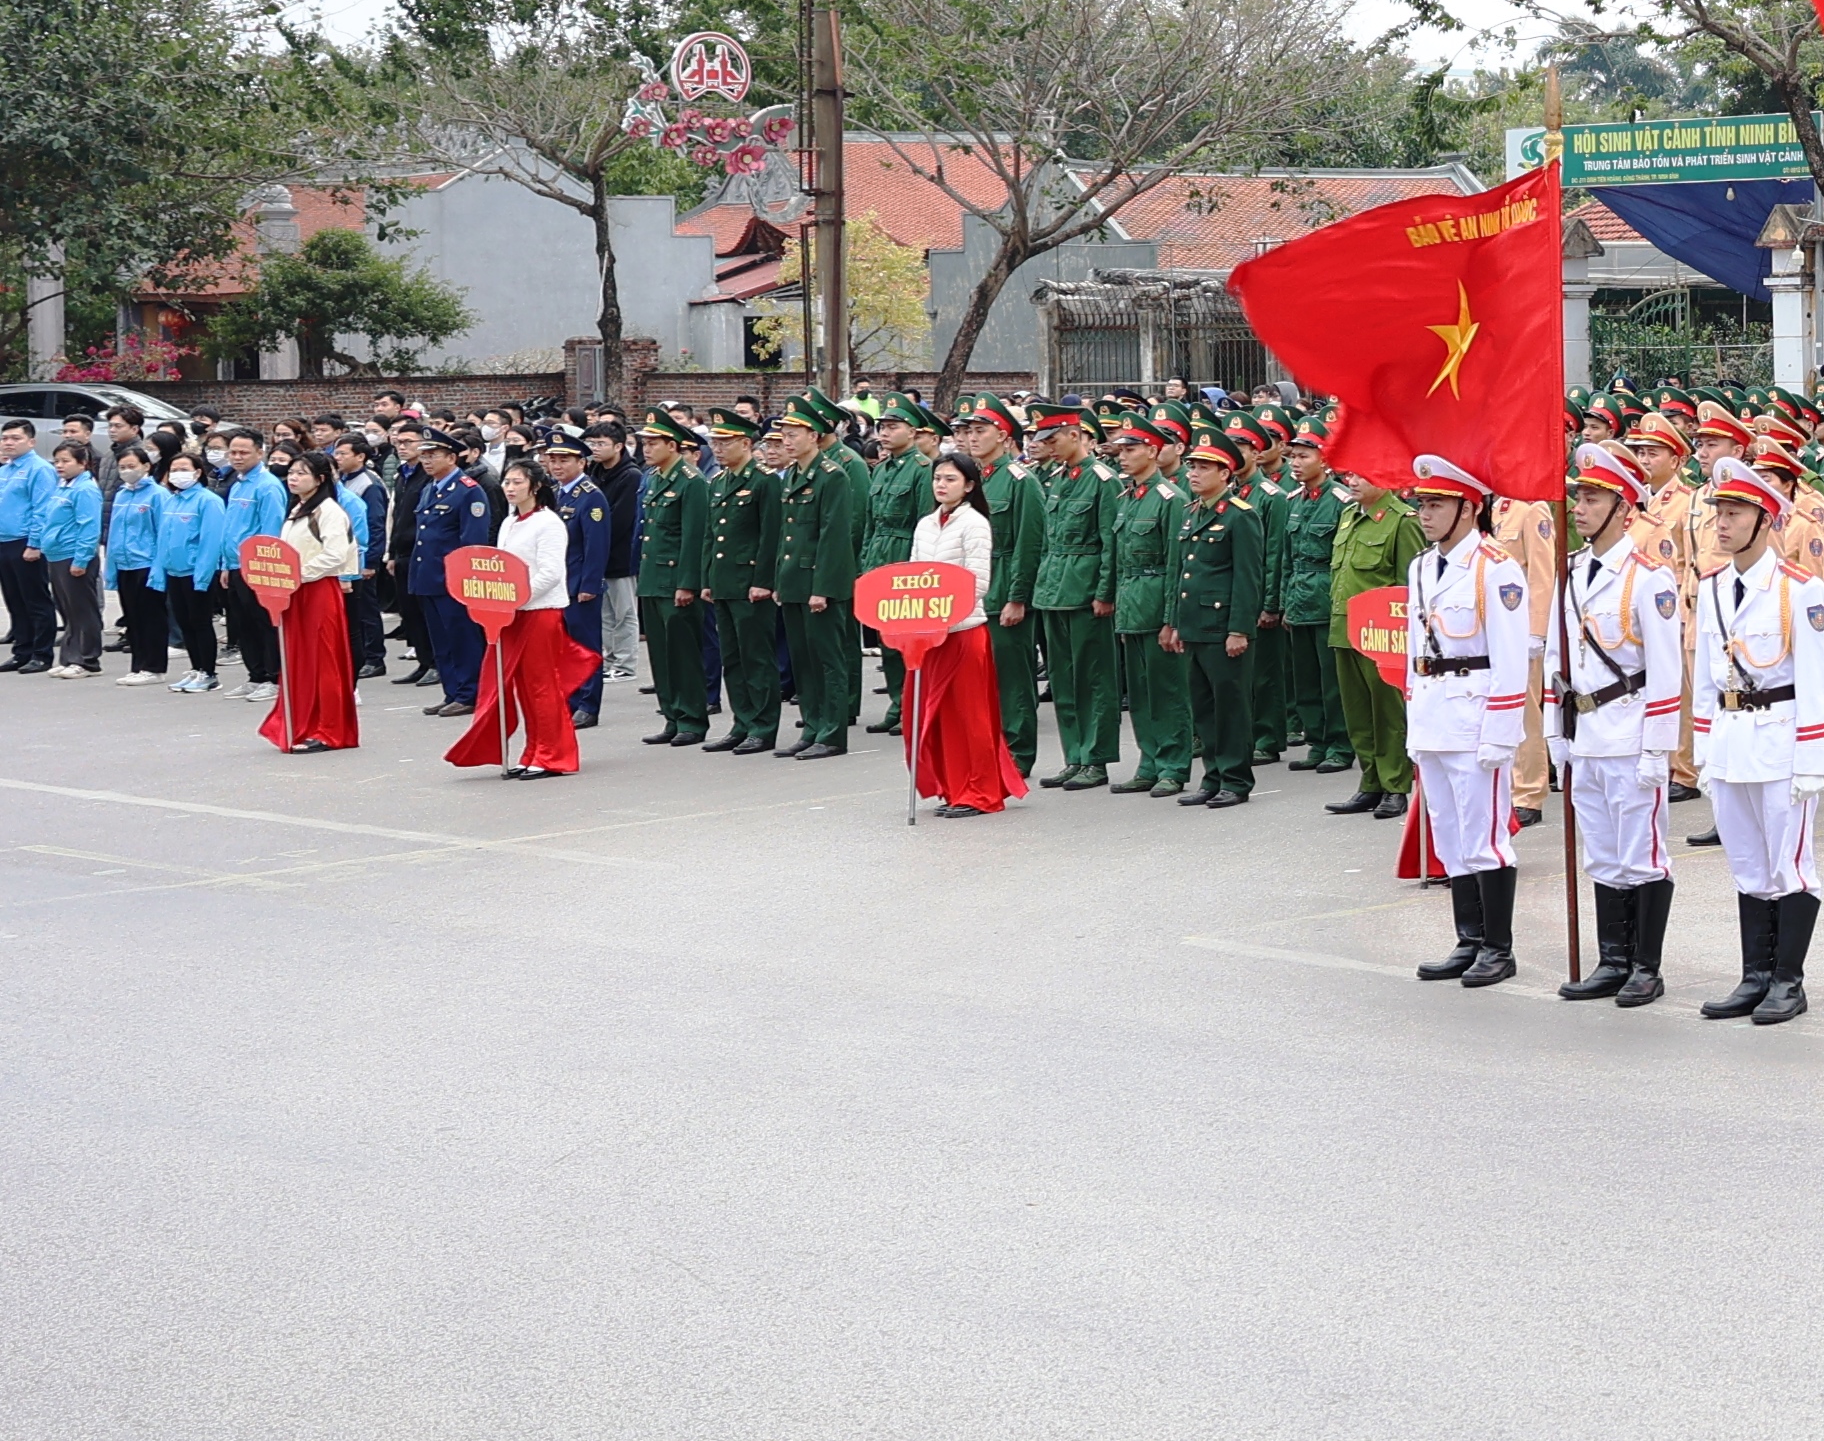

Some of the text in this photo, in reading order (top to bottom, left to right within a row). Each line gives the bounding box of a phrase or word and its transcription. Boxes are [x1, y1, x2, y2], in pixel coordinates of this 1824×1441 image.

[1573, 128, 1596, 157] HỘI
[1599, 131, 1631, 153] SINH
[1635, 126, 1660, 155] VẬT
[1663, 122, 1700, 149] CẢNH
[1704, 120, 1735, 147] TỈNH
[1740, 123, 1774, 145] NINH
[1583, 160, 1611, 171] TRUNG
[1612, 157, 1631, 170] TÂM
[1633, 154, 1650, 169] BẢO
[1671, 154, 1684, 167] VÀ
[1685, 153, 1708, 166] PHÁT
[1710, 149, 1734, 165] TRIỂN
[1735, 153, 1756, 165] SINH
[1758, 149, 1777, 166] VẬT
[1778, 147, 1804, 162] CẢNH
[1405, 215, 1442, 248] BẢO
[1436, 214, 1463, 244] VỆ
[1459, 216, 1478, 240] AN
[1479, 209, 1500, 237] NINH
[1511, 190, 1537, 225] QUỐC
[256, 542, 281, 559] KHỐI
[471, 554, 505, 572] KHỐI
[463, 575, 516, 602] BIÊN PHÒNG
[892, 568, 941, 590] KHỐI
[878, 594, 954, 623] QUÂN SỰ
[1361, 619, 1388, 653] CẢNH
